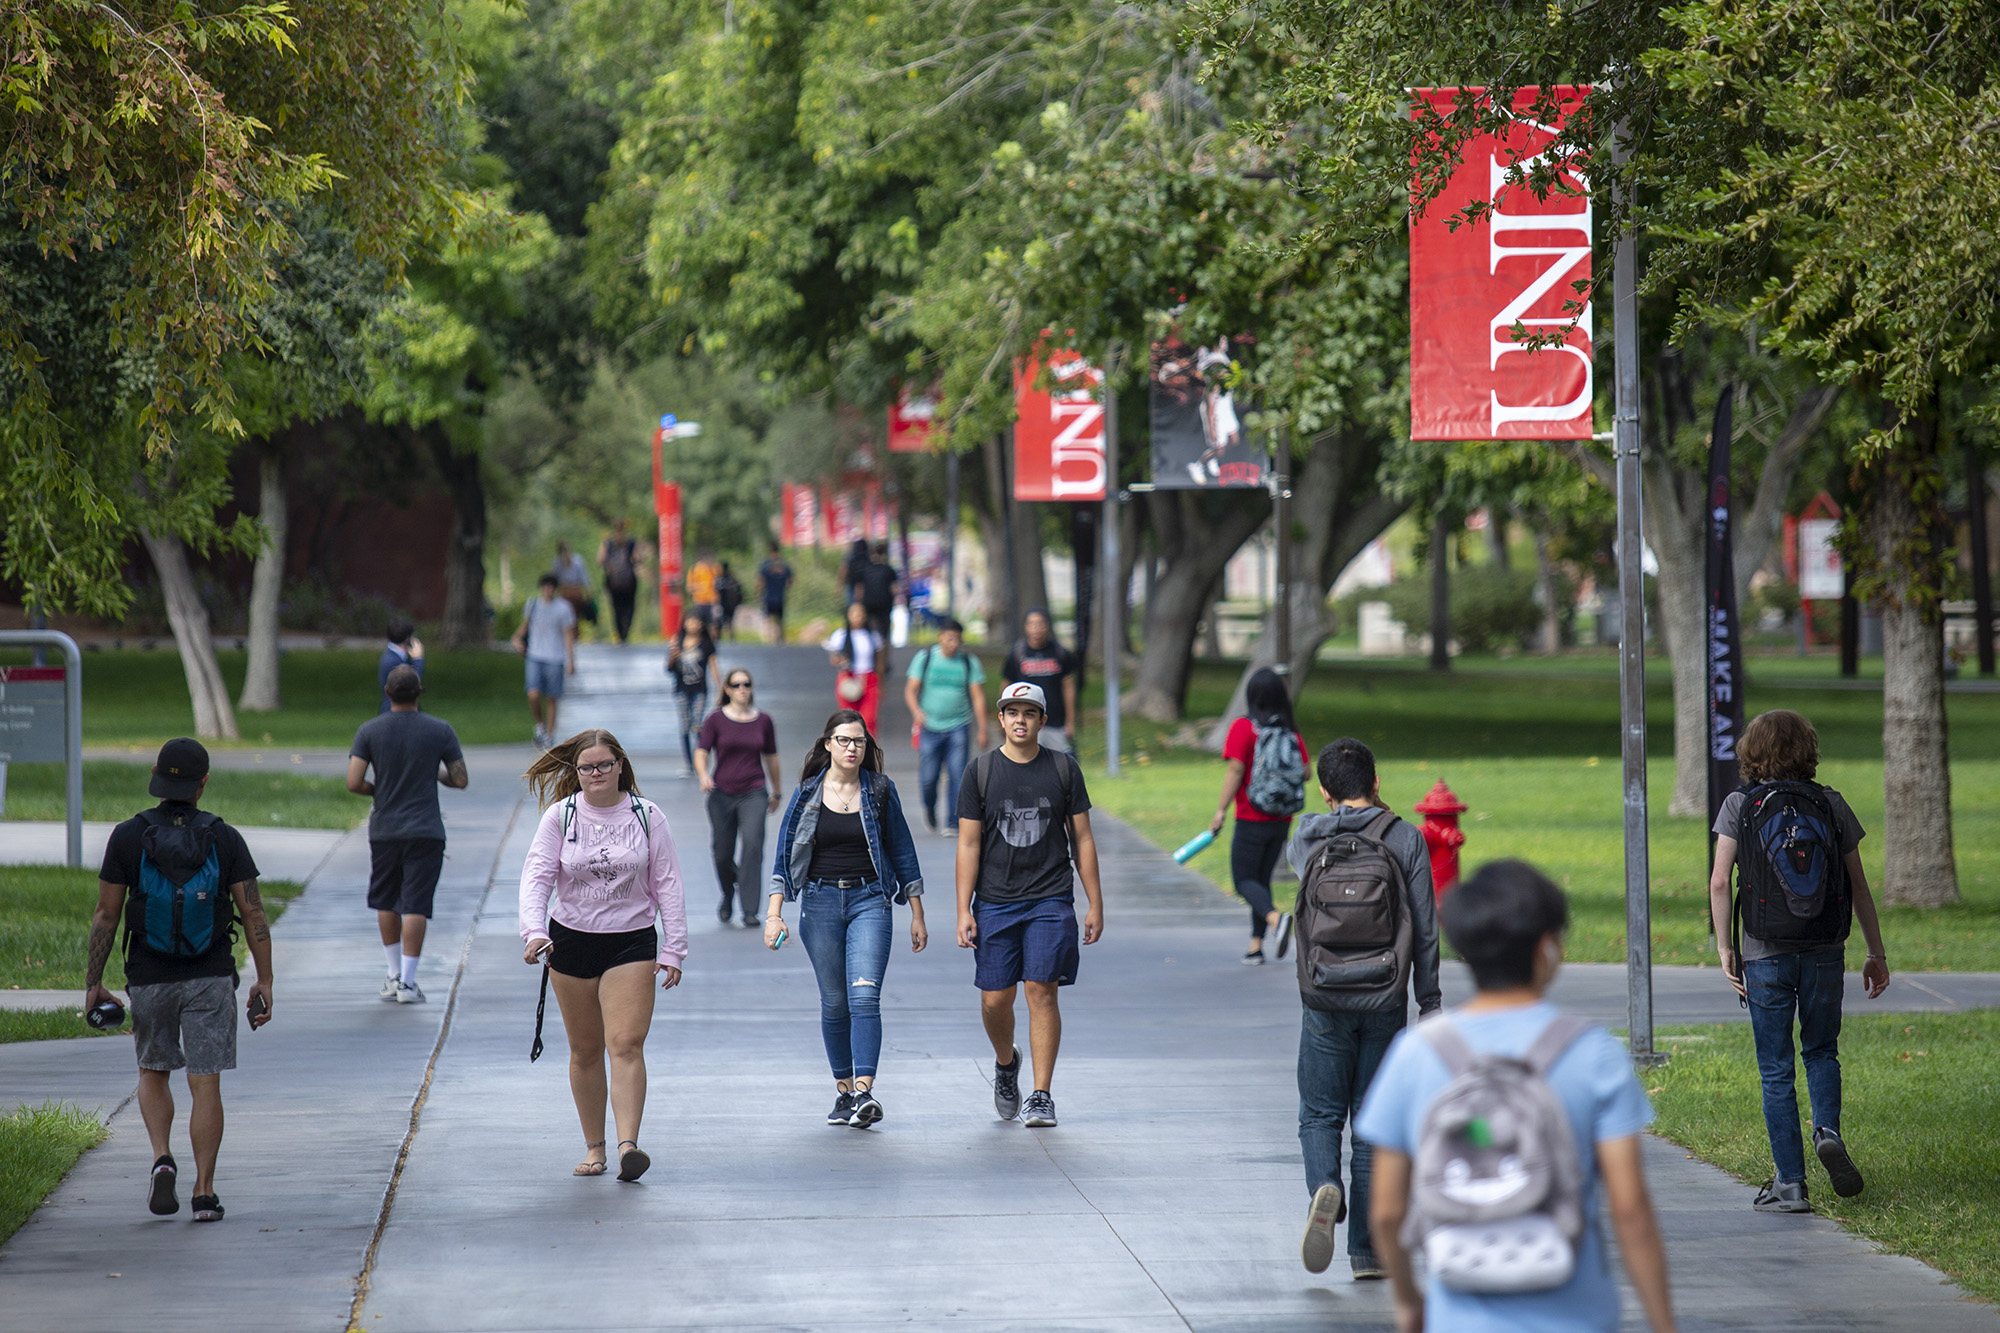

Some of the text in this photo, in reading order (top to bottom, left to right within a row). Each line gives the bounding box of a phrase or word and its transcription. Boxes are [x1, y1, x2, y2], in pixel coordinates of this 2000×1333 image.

[1012, 685, 1031, 697] C
[1715, 608, 1736, 760] MAKE AN
